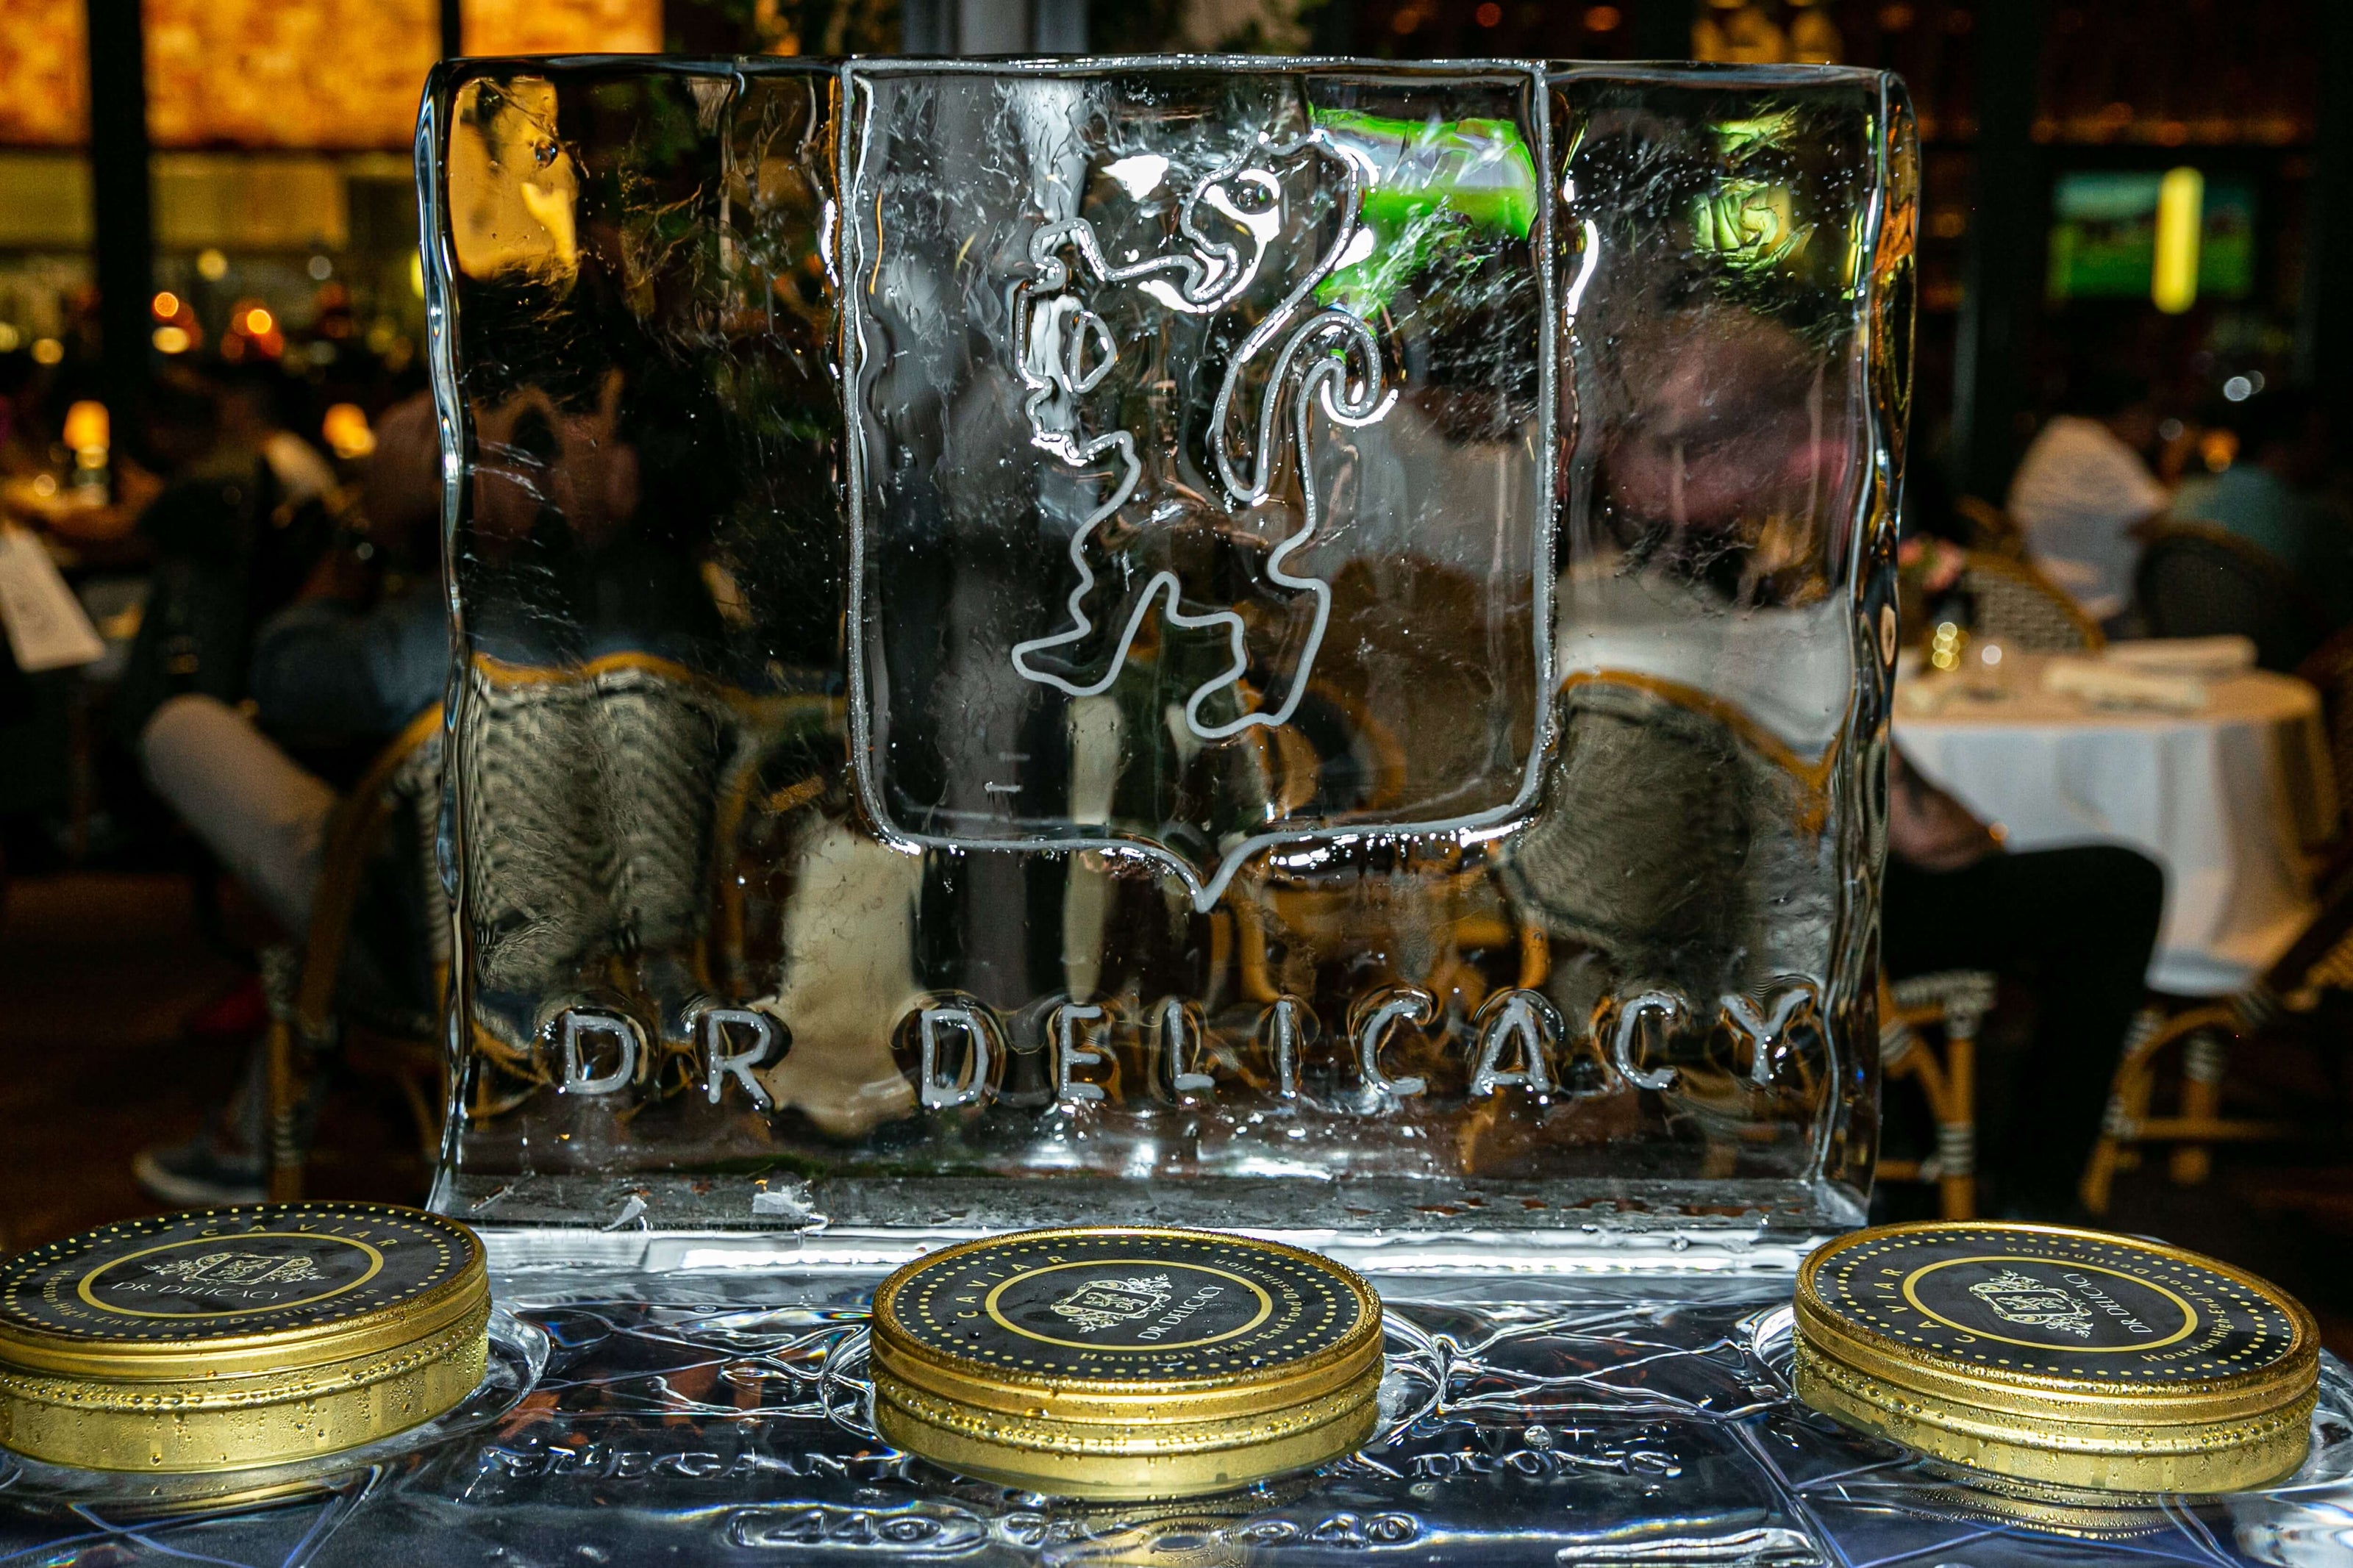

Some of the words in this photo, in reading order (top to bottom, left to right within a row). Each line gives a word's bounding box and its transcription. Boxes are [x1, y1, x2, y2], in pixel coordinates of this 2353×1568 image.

[561, 1007, 776, 1111] DR
[919, 989, 1810, 1109] DELICACY
[201, 1223, 398, 1247] CAVIAR
[2004, 1246, 2151, 1275] Destination
[43, 1270, 75, 1304] Houston
[111, 1281, 151, 1292] DR
[955, 1256, 1068, 1319] CAVIAR
[1214, 1258, 1301, 1300] Destination
[2152, 1275, 2204, 1297] Food
[229, 1289, 379, 1324] Destination
[1873, 1268, 1977, 1344] CAVIAR
[2058, 1271, 2131, 1316] DELICACY
[51, 1301, 142, 1327] High-End
[147, 1320, 217, 1328] Food
[1137, 1325, 1171, 1340] DR
[1158, 1284, 1225, 1325] DELICACY
[1280, 1300, 1303, 1322] Food
[2120, 1317, 2153, 1333] DR
[1079, 1352, 1196, 1362] Houston
[2140, 1336, 2222, 1363] Houston
